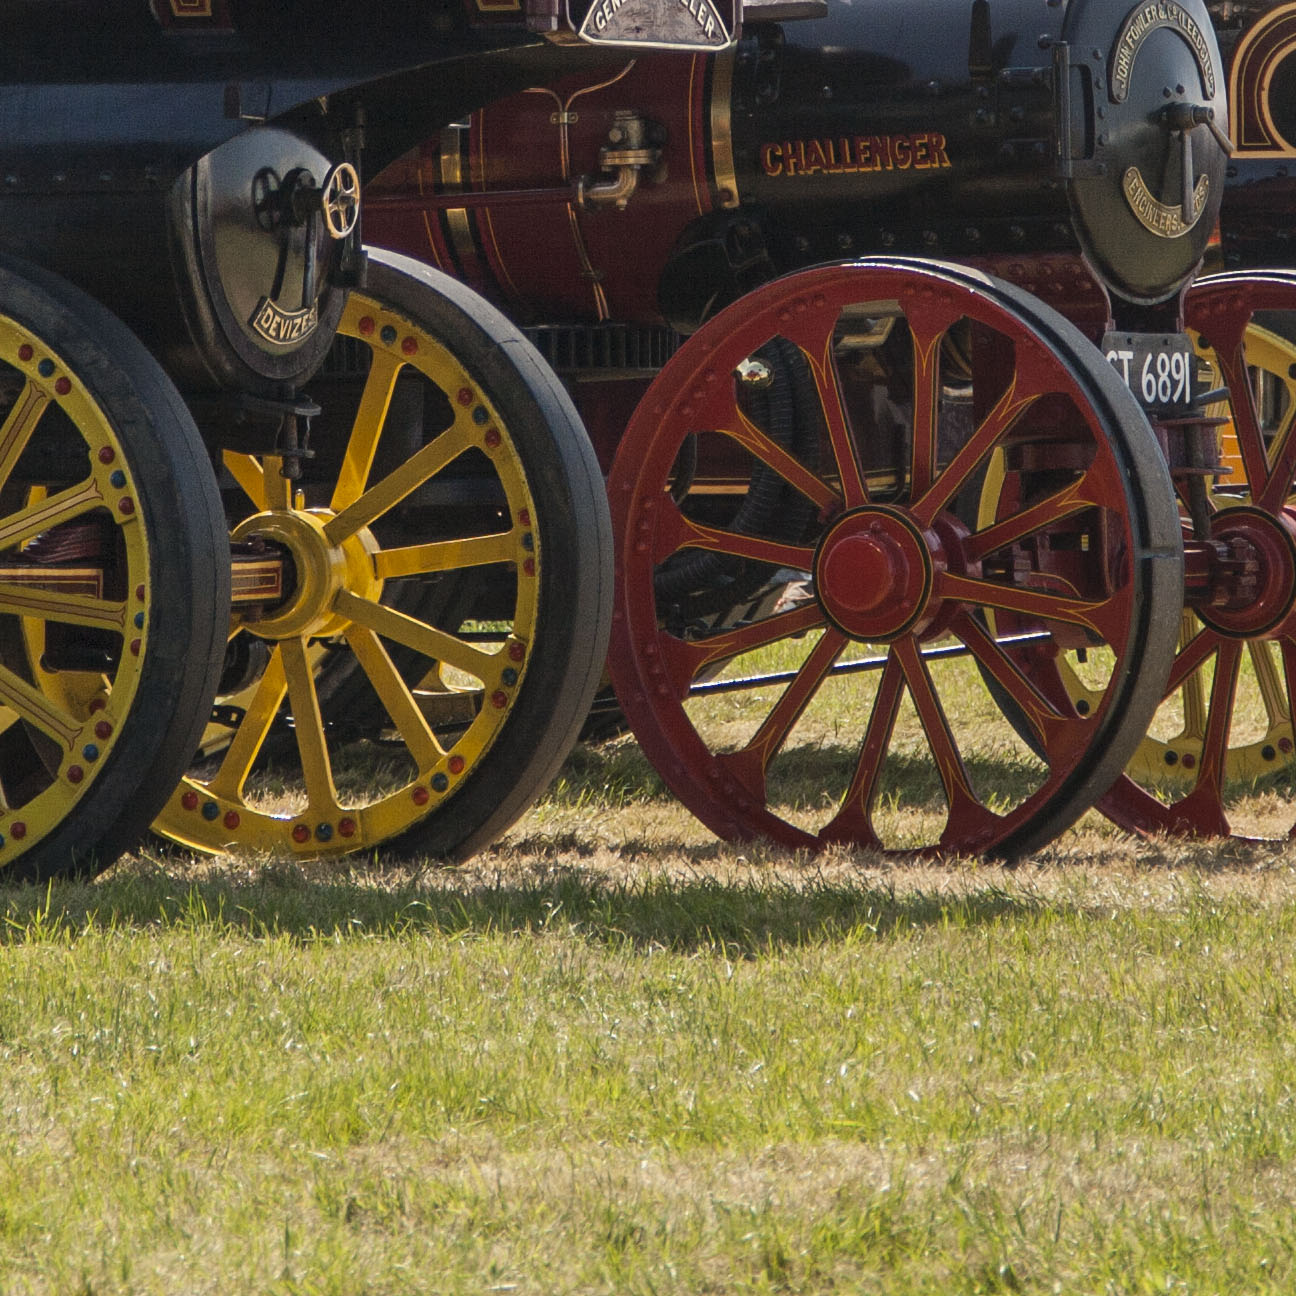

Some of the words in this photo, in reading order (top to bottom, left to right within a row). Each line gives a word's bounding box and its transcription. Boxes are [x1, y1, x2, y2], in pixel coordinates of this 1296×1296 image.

[1115, 45, 1131, 89] JOHN
[1125, 4, 1158, 49] FOWLER
[1157, 3, 1168, 20] &
[761, 132, 953, 177] CHALLENGER
[261, 307, 315, 340] DEVIZES
[1106, 350, 1134, 387] T
[1141, 352, 1191, 404] 6891
